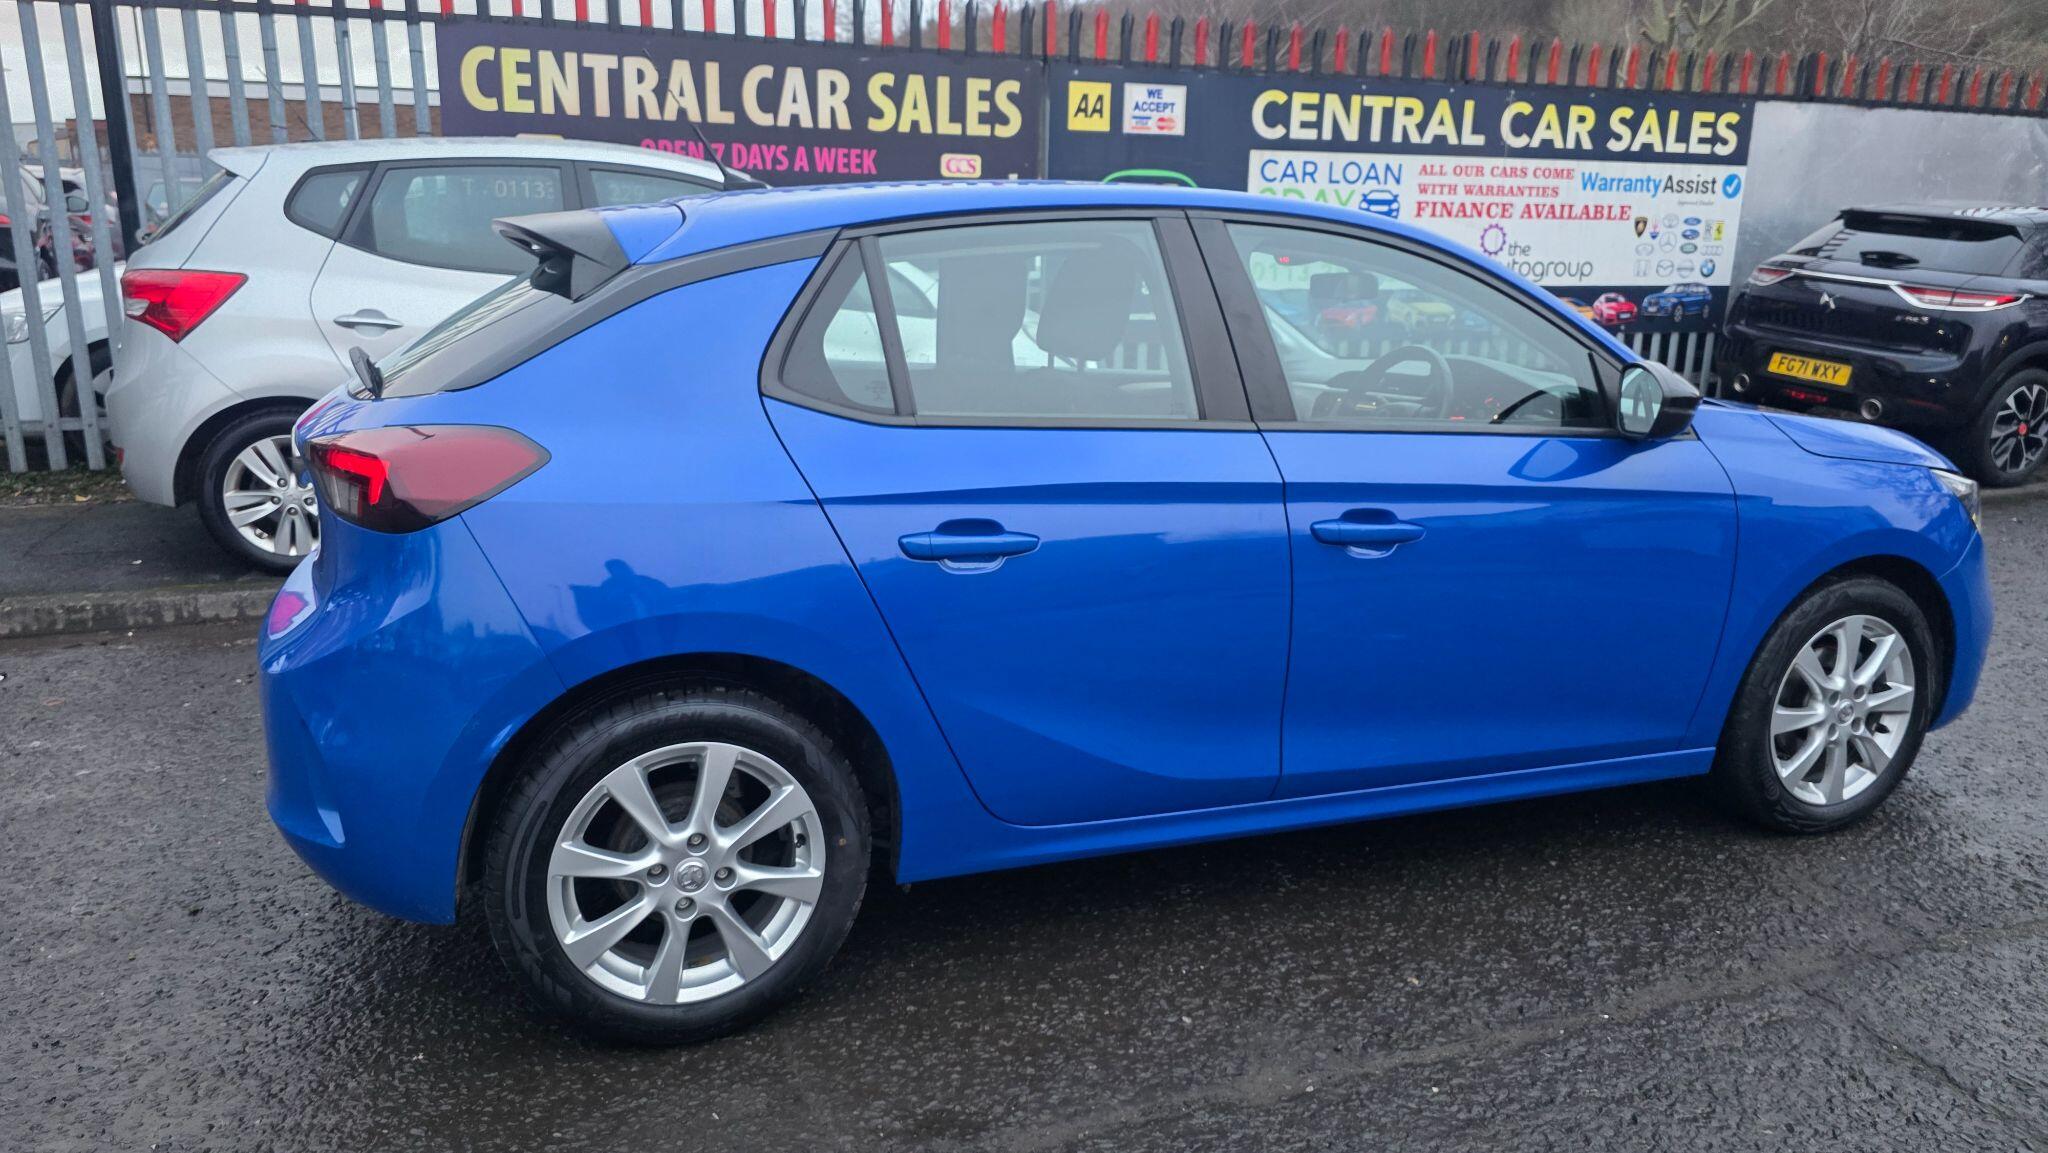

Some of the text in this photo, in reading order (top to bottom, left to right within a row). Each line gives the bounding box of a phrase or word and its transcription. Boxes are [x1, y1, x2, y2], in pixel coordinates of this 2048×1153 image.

[460, 46, 1022, 138] CENTRAL CAR SALES
[1147, 88, 1163, 100] WE
[1074, 93, 1105, 119] AA
[1133, 101, 1176, 113] ACCEPT
[1252, 90, 1741, 157] CENTRAL CAR SALES
[711, 143, 725, 164] 7
[731, 143, 789, 171] DAYS
[793, 145, 809, 172] A
[813, 147, 877, 175] WEEK
[1260, 159, 1403, 186] CAR LOAN
[1419, 164, 1574, 180] ALL OUR CARS COME
[1418, 184, 1559, 198] WITH WARRANTIES
[1415, 201, 1632, 221] FINANCE AVAILABLE
[1508, 241, 1531, 257] the
[1777, 356, 1840, 380] FG71 WXY
